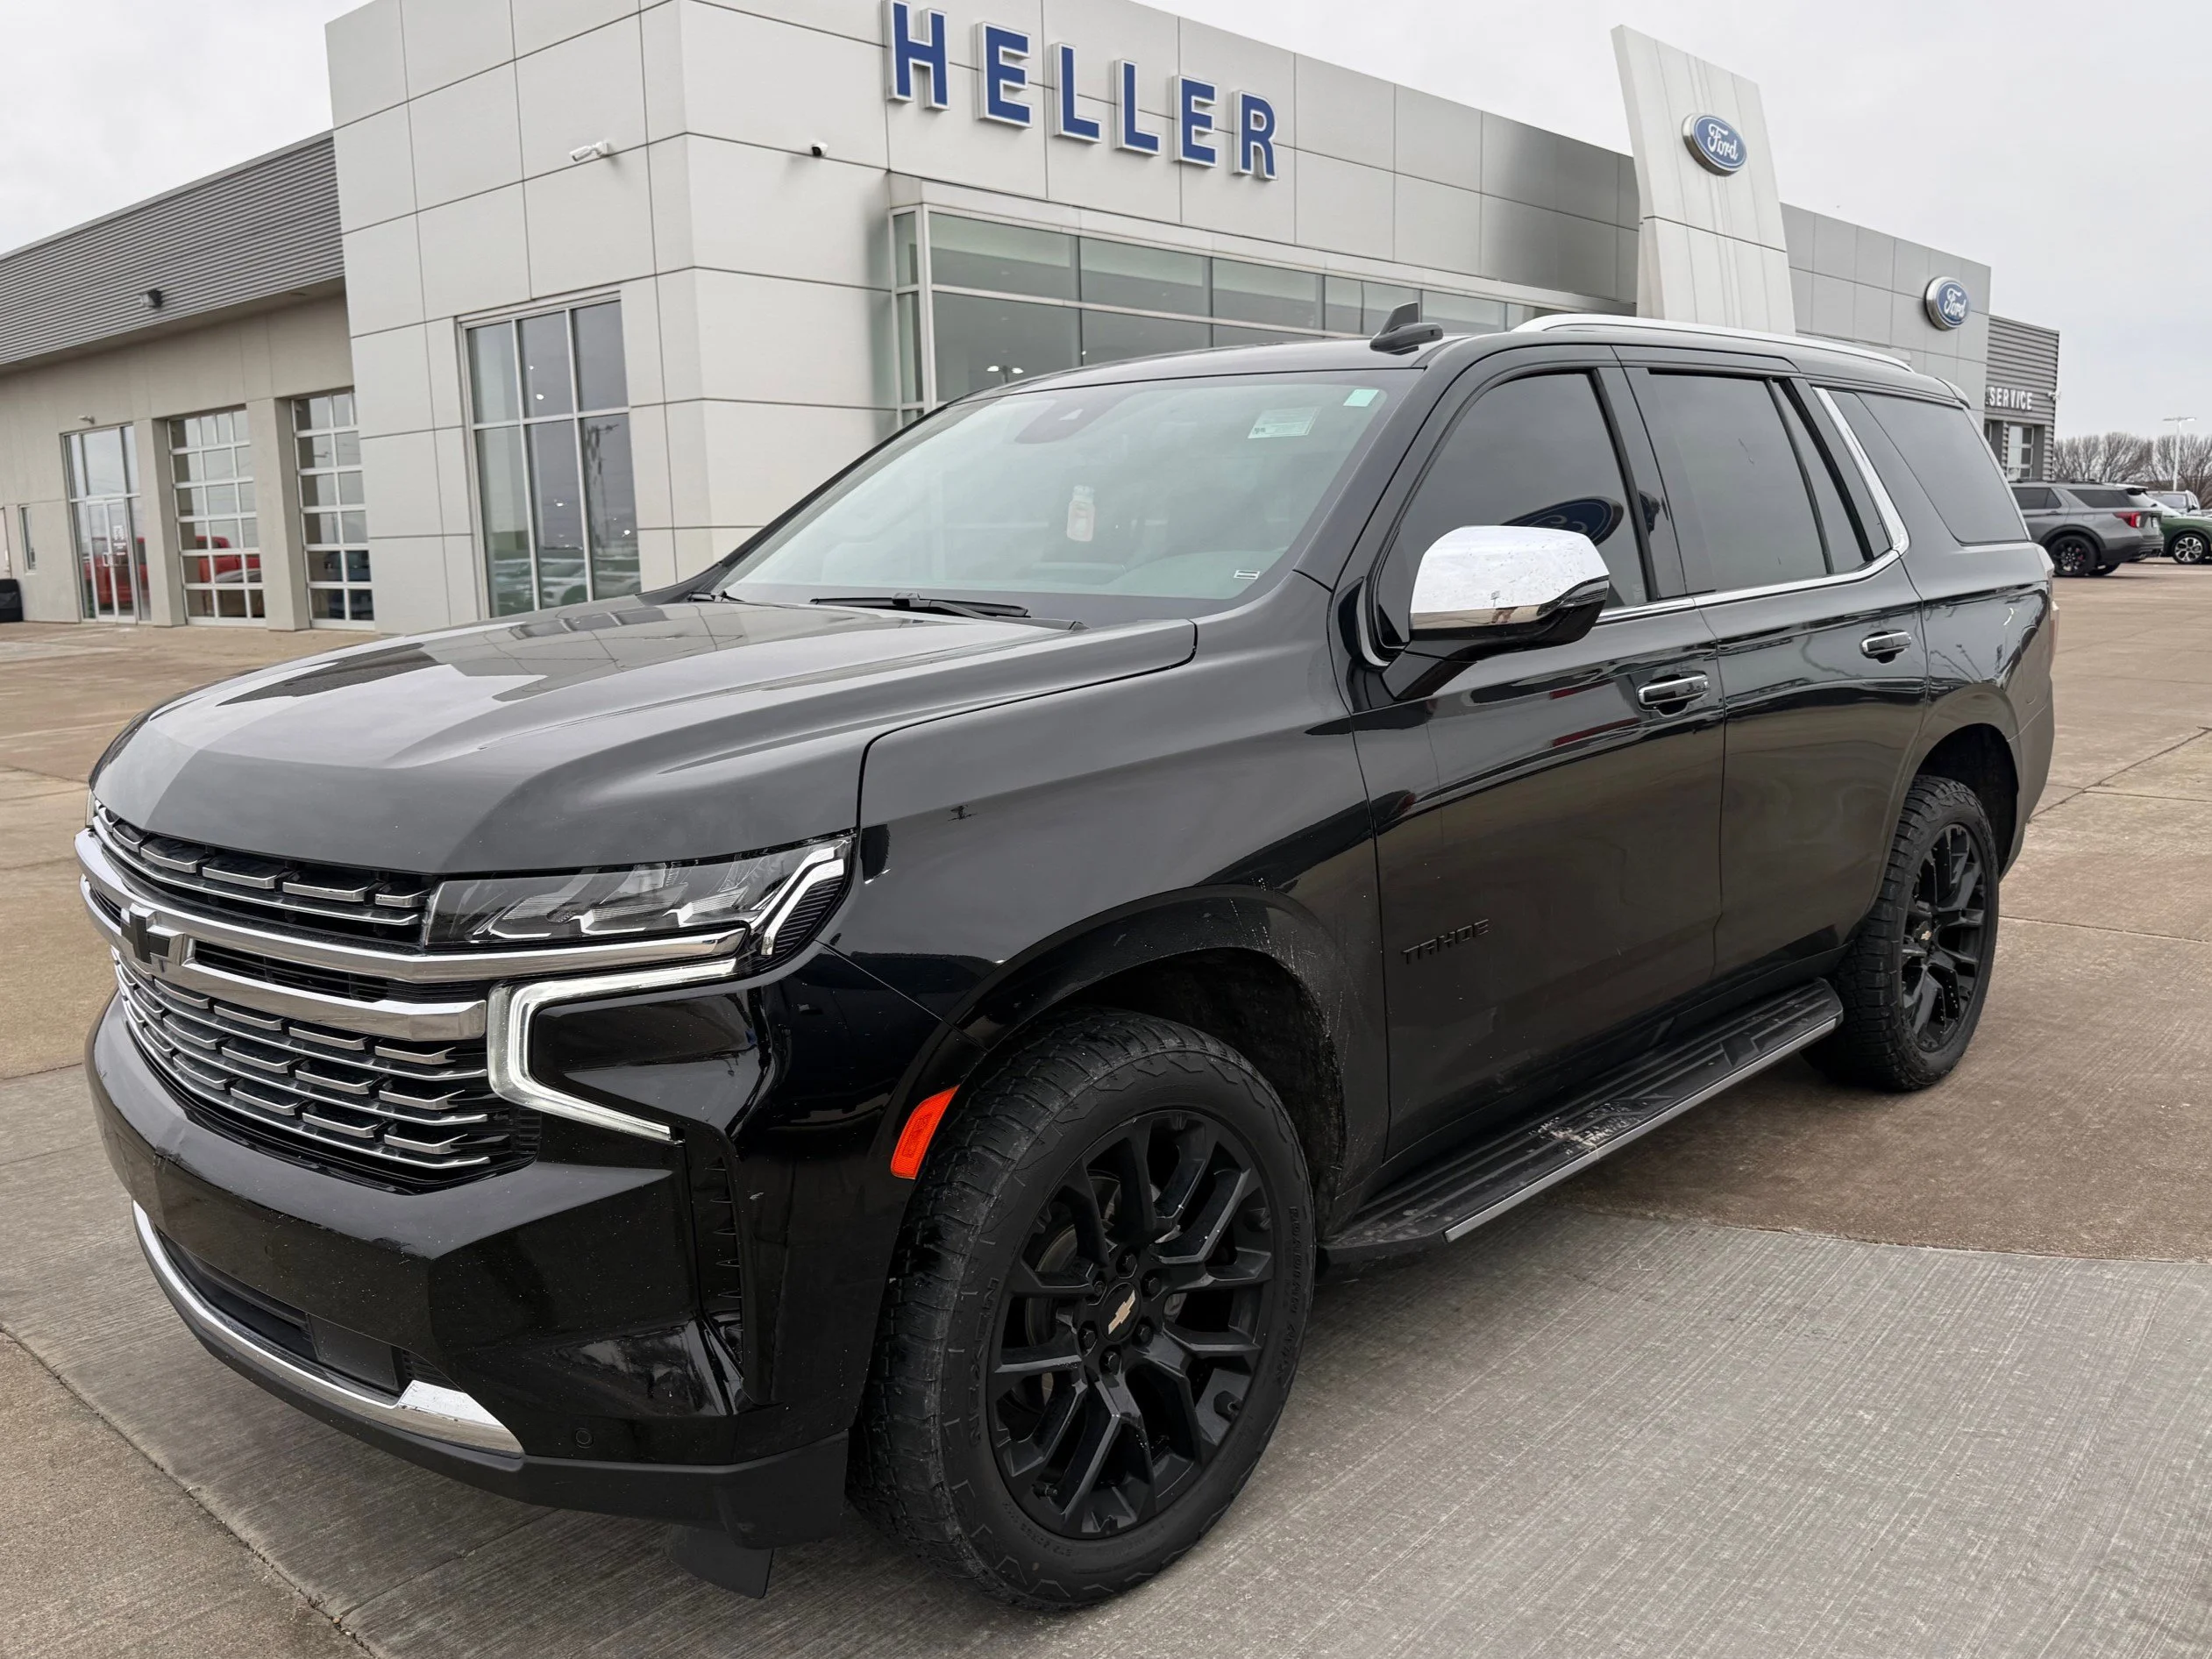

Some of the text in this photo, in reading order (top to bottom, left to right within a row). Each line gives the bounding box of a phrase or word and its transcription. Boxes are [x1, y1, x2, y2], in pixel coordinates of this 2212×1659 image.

[888, 1, 1277, 180] HELLER
[1707, 123, 1739, 160] Ford
[1943, 288, 1967, 317] Ford
[1989, 386, 2032, 410] SERVICE
[1401, 919, 1490, 965] TAHOE
